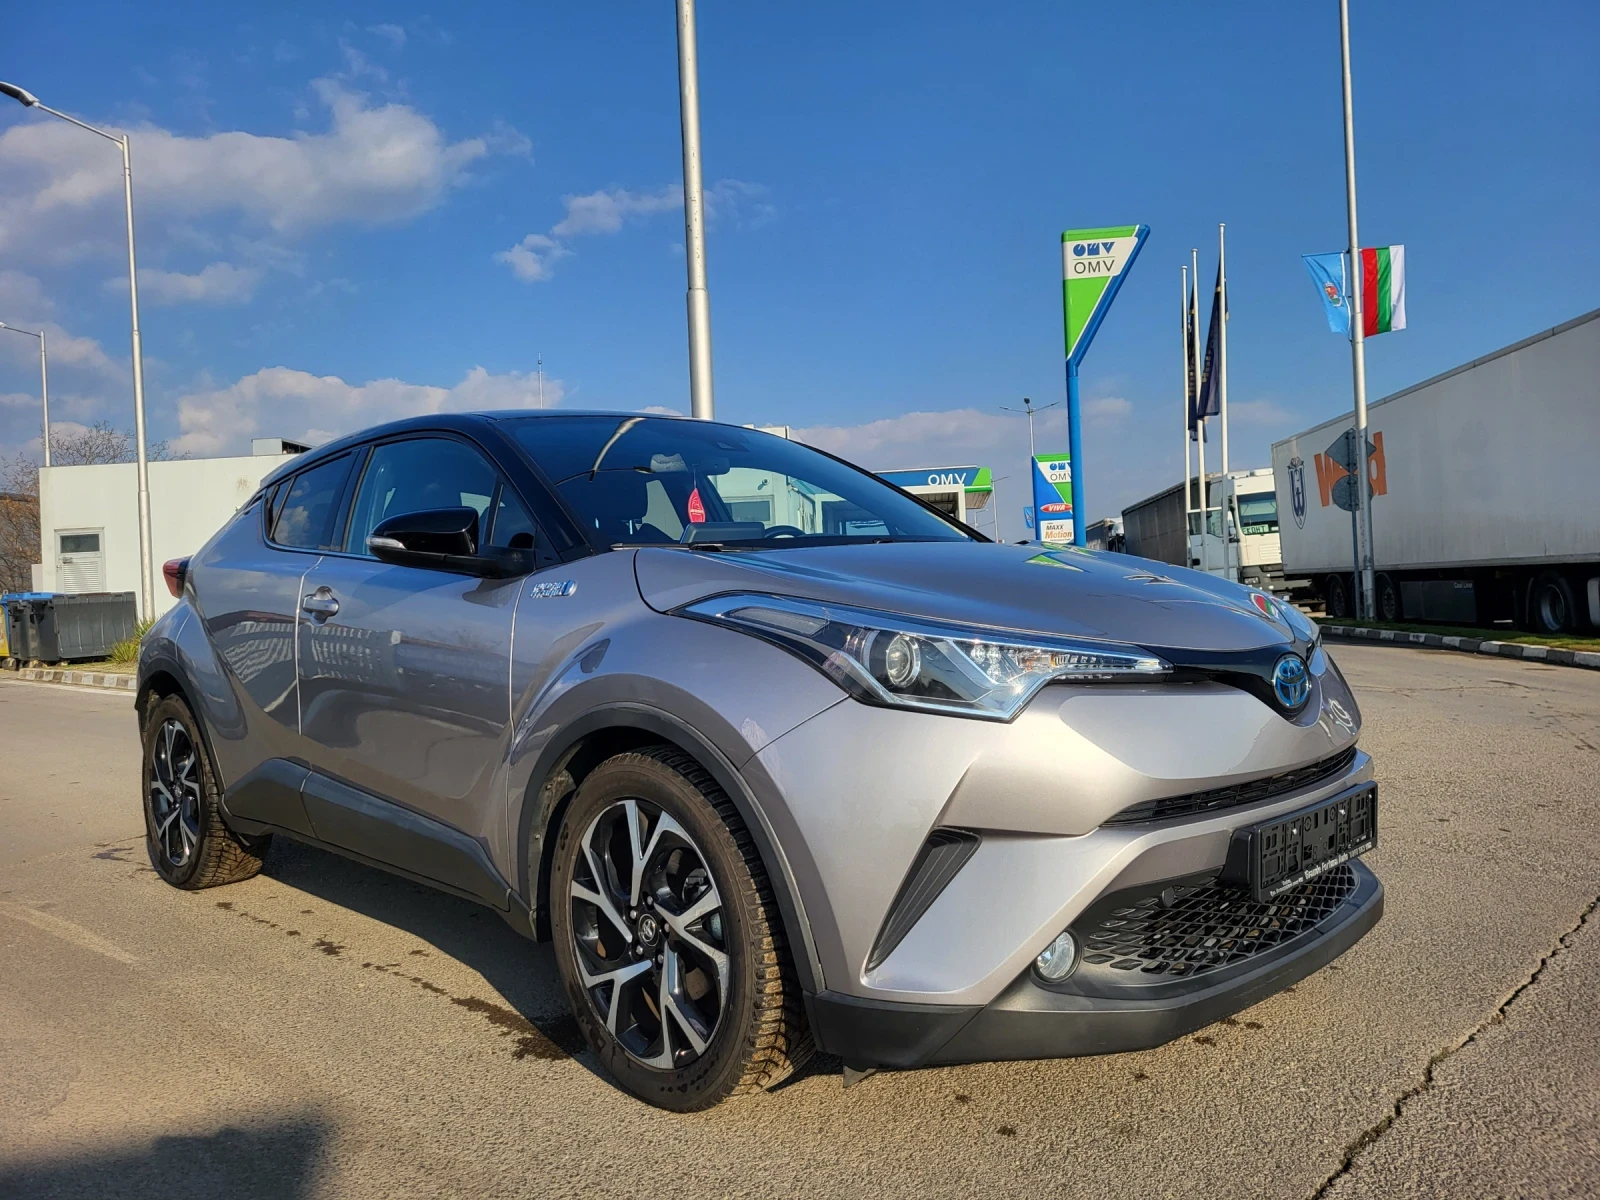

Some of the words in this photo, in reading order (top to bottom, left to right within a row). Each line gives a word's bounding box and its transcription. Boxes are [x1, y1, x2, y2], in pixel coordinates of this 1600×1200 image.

[1074, 260, 1115, 274] OMV
[928, 472, 966, 485] OMV
[1048, 504, 1066, 512] VIVA
[1045, 530, 1072, 539] Motion
